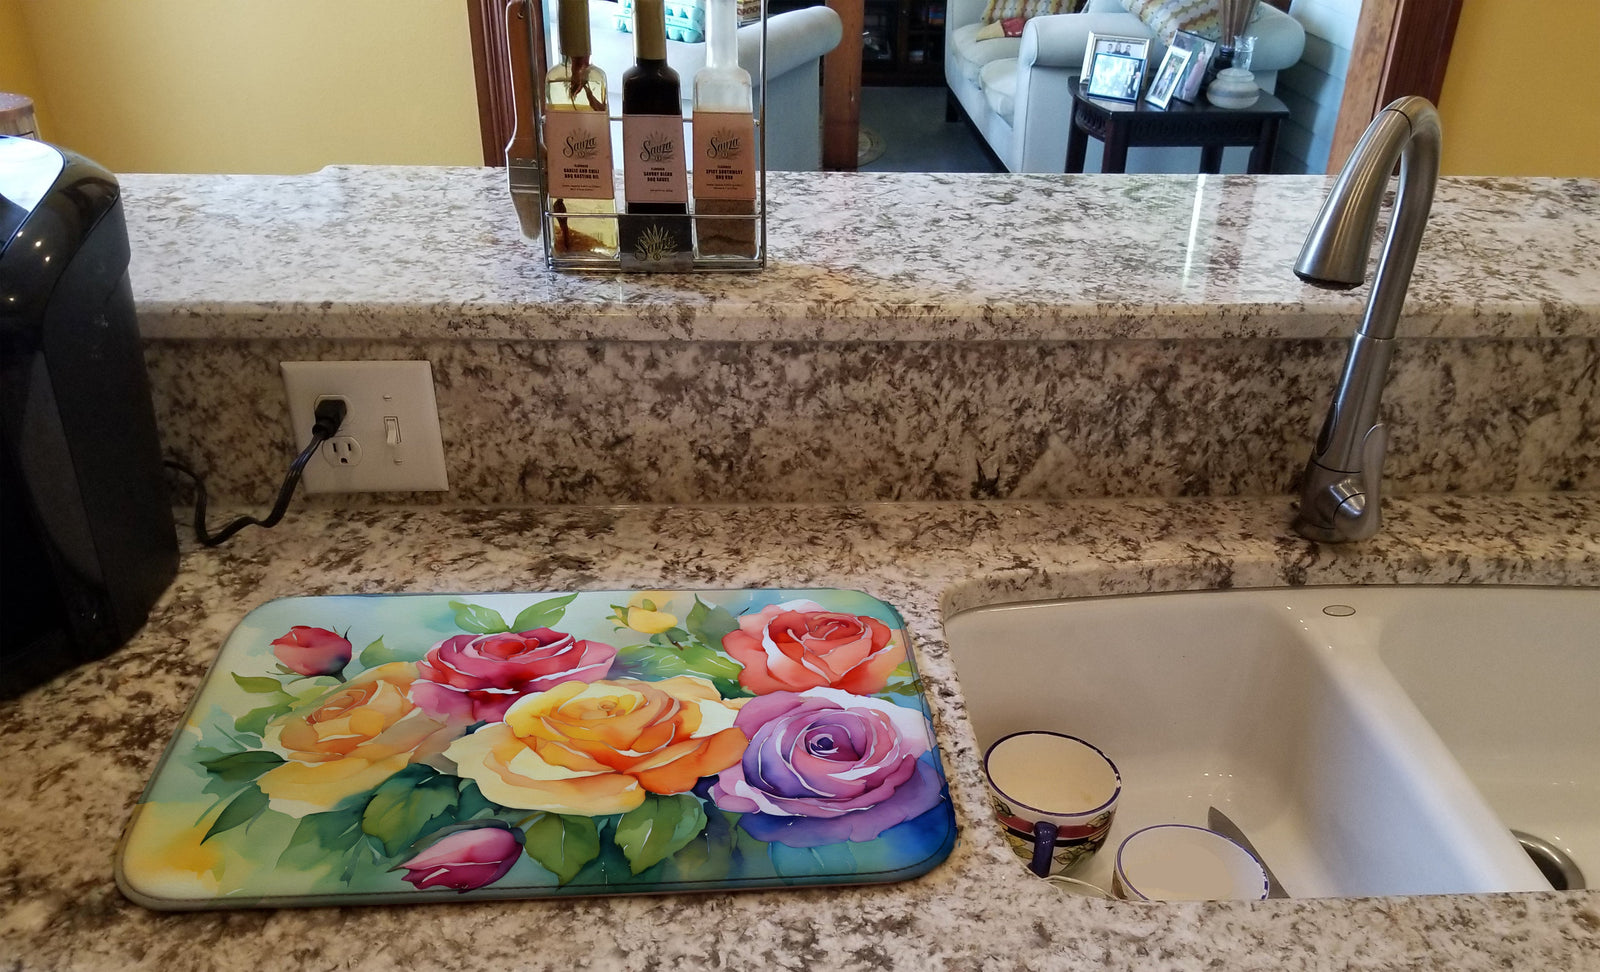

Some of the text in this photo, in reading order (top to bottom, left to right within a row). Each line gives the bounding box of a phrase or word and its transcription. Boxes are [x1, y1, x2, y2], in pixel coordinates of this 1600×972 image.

[563, 136, 597, 158] Sauza
[640, 140, 673, 162] Sauza
[707, 136, 740, 159] Sauza
